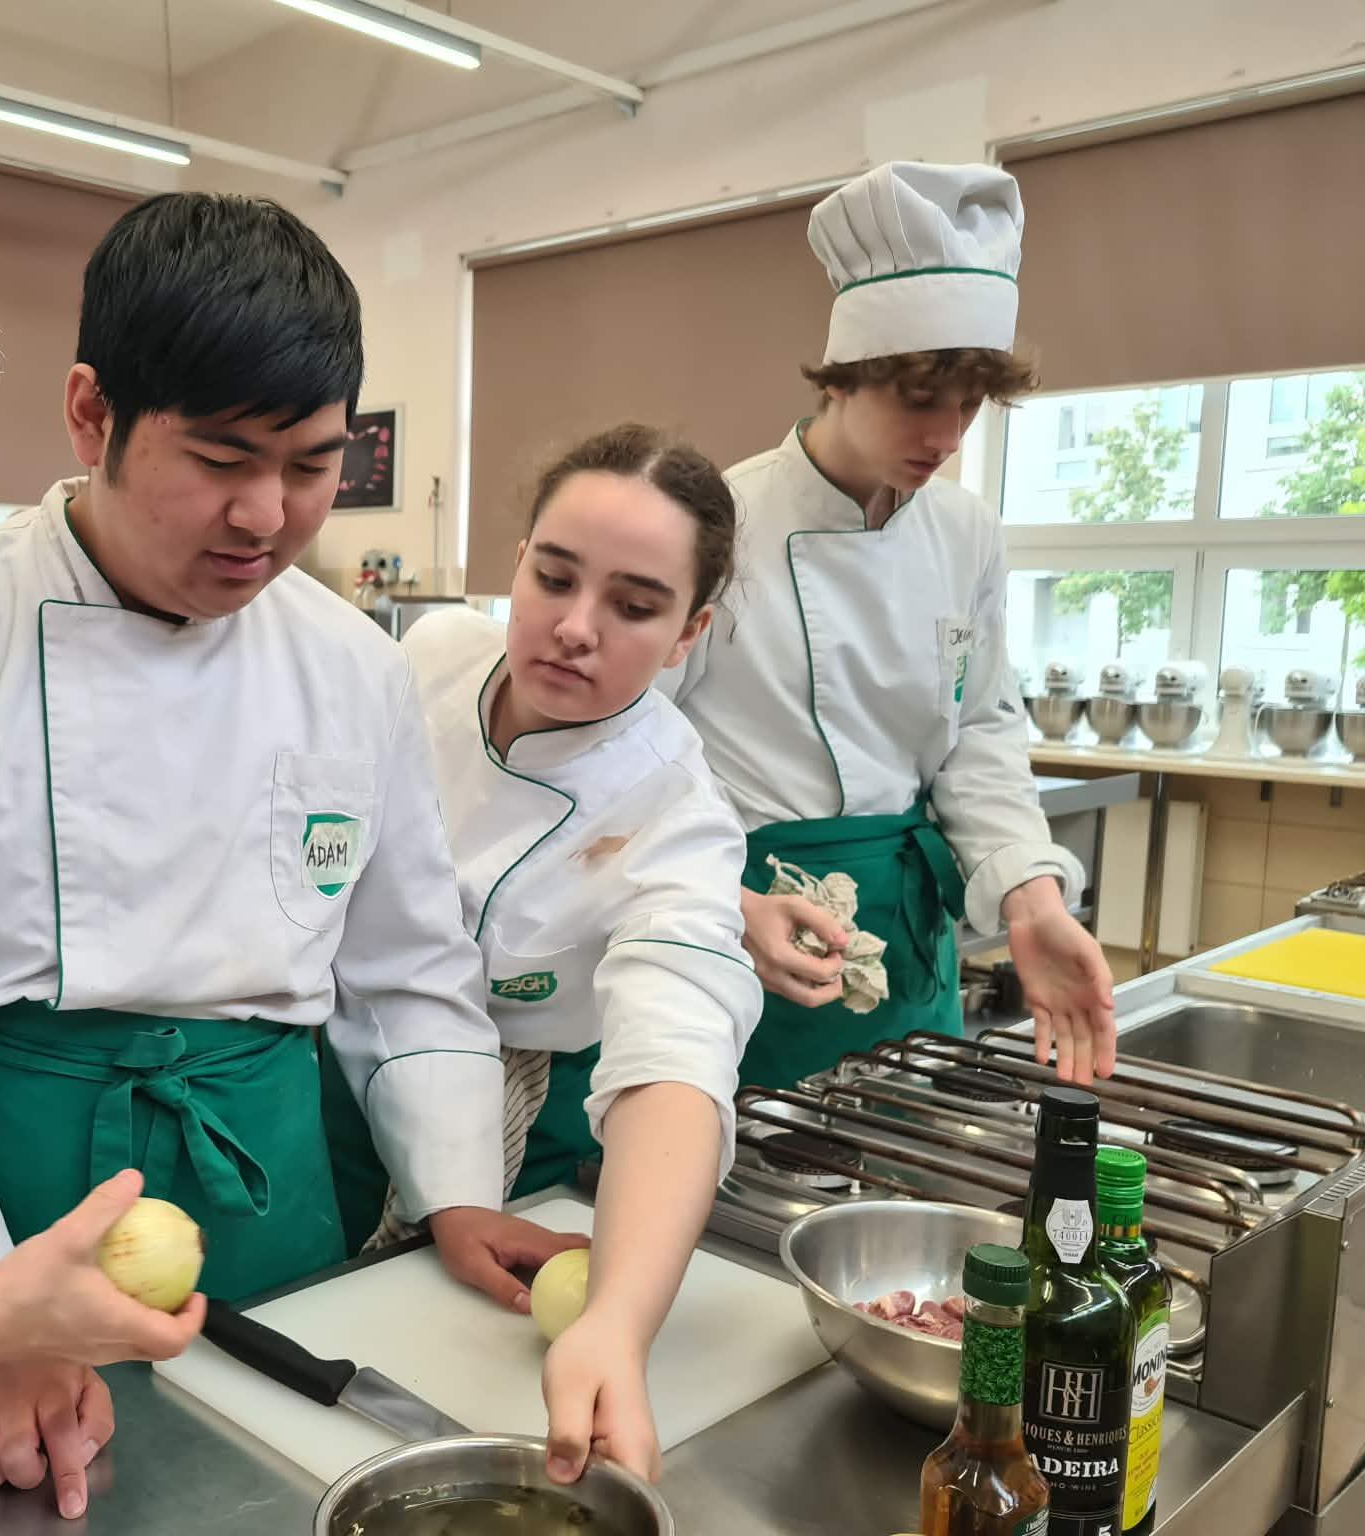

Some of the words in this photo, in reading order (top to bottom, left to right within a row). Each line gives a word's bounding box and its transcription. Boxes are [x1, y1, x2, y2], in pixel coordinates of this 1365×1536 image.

[306, 841, 348, 869] ADAM
[498, 975, 550, 993] ZSGH
[1132, 1343, 1169, 1388] MONIN
[1025, 1422, 1061, 1443] IQUES
[1063, 1429, 1074, 1446] &
[1076, 1423, 1127, 1447] HENRIQUES
[1028, 1452, 1120, 1479] ADEIRA
